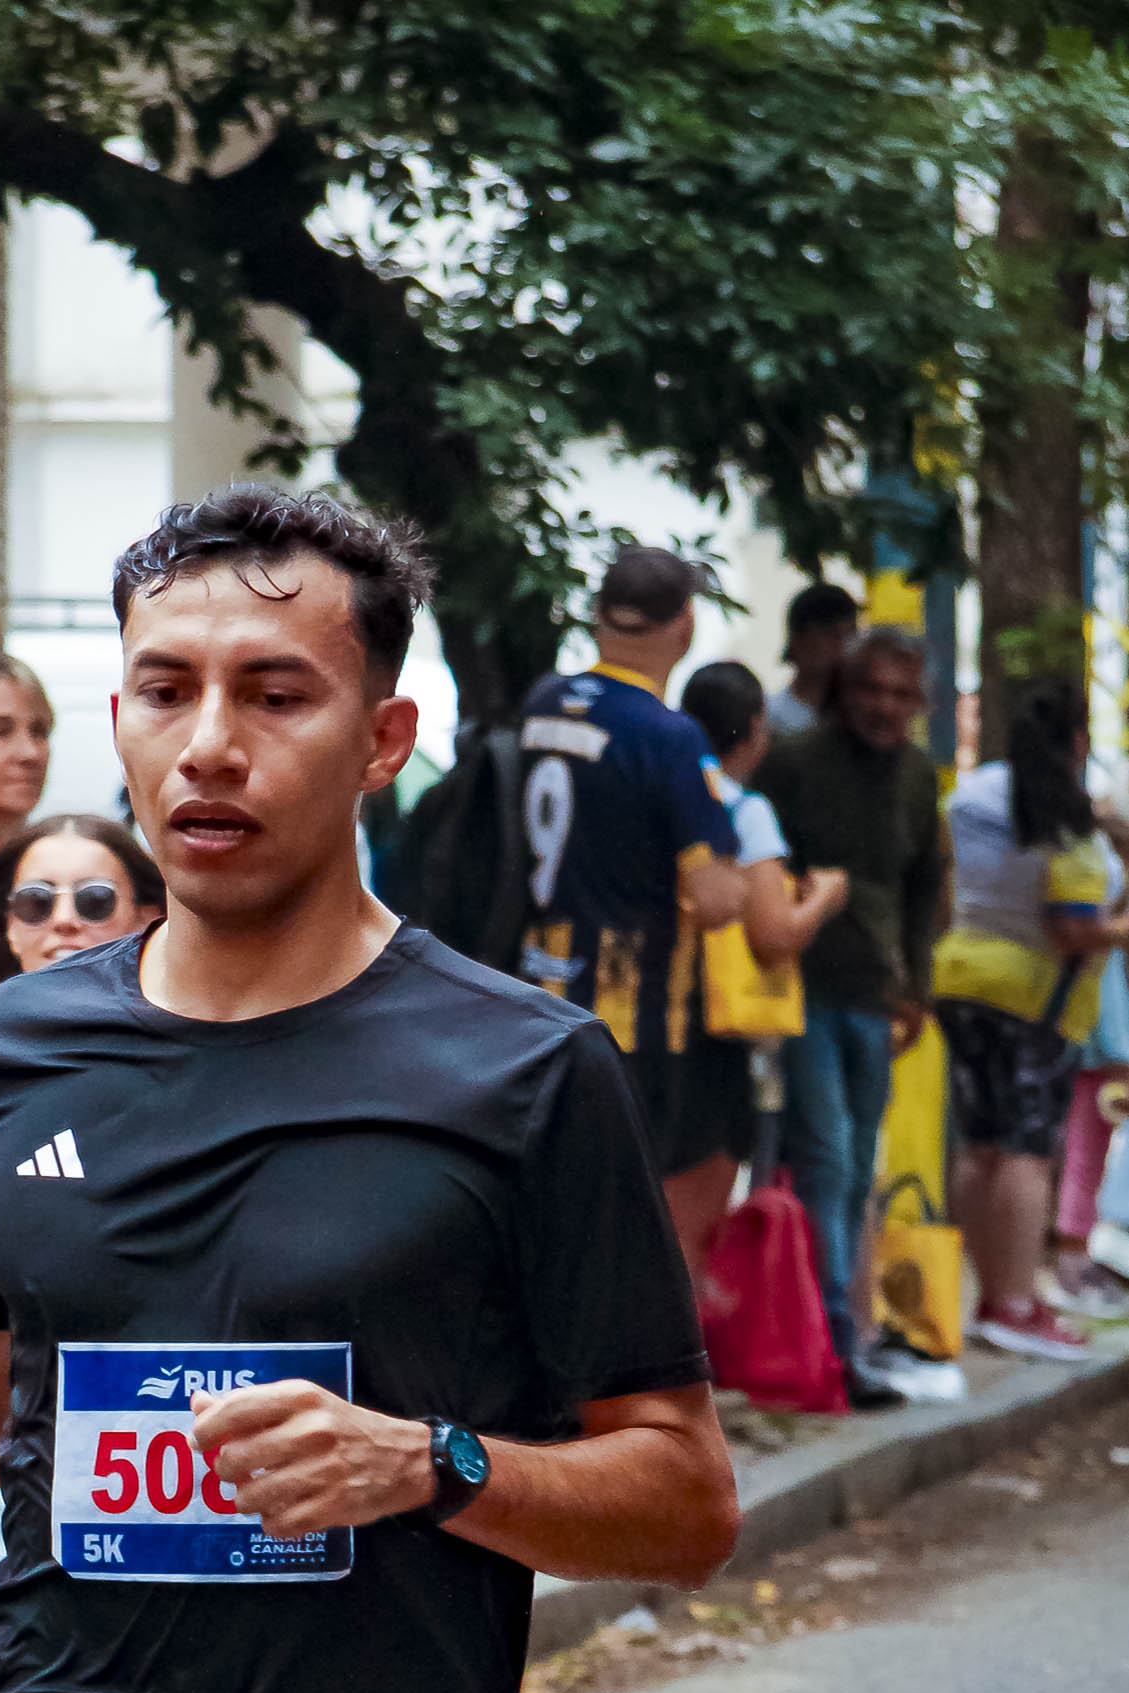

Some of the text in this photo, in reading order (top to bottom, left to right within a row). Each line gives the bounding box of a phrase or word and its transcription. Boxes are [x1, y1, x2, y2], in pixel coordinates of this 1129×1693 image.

[183, 1370, 255, 1397] RUS
[83, 1534, 124, 1562] 5K
[251, 1544, 326, 1554] CANALLA
